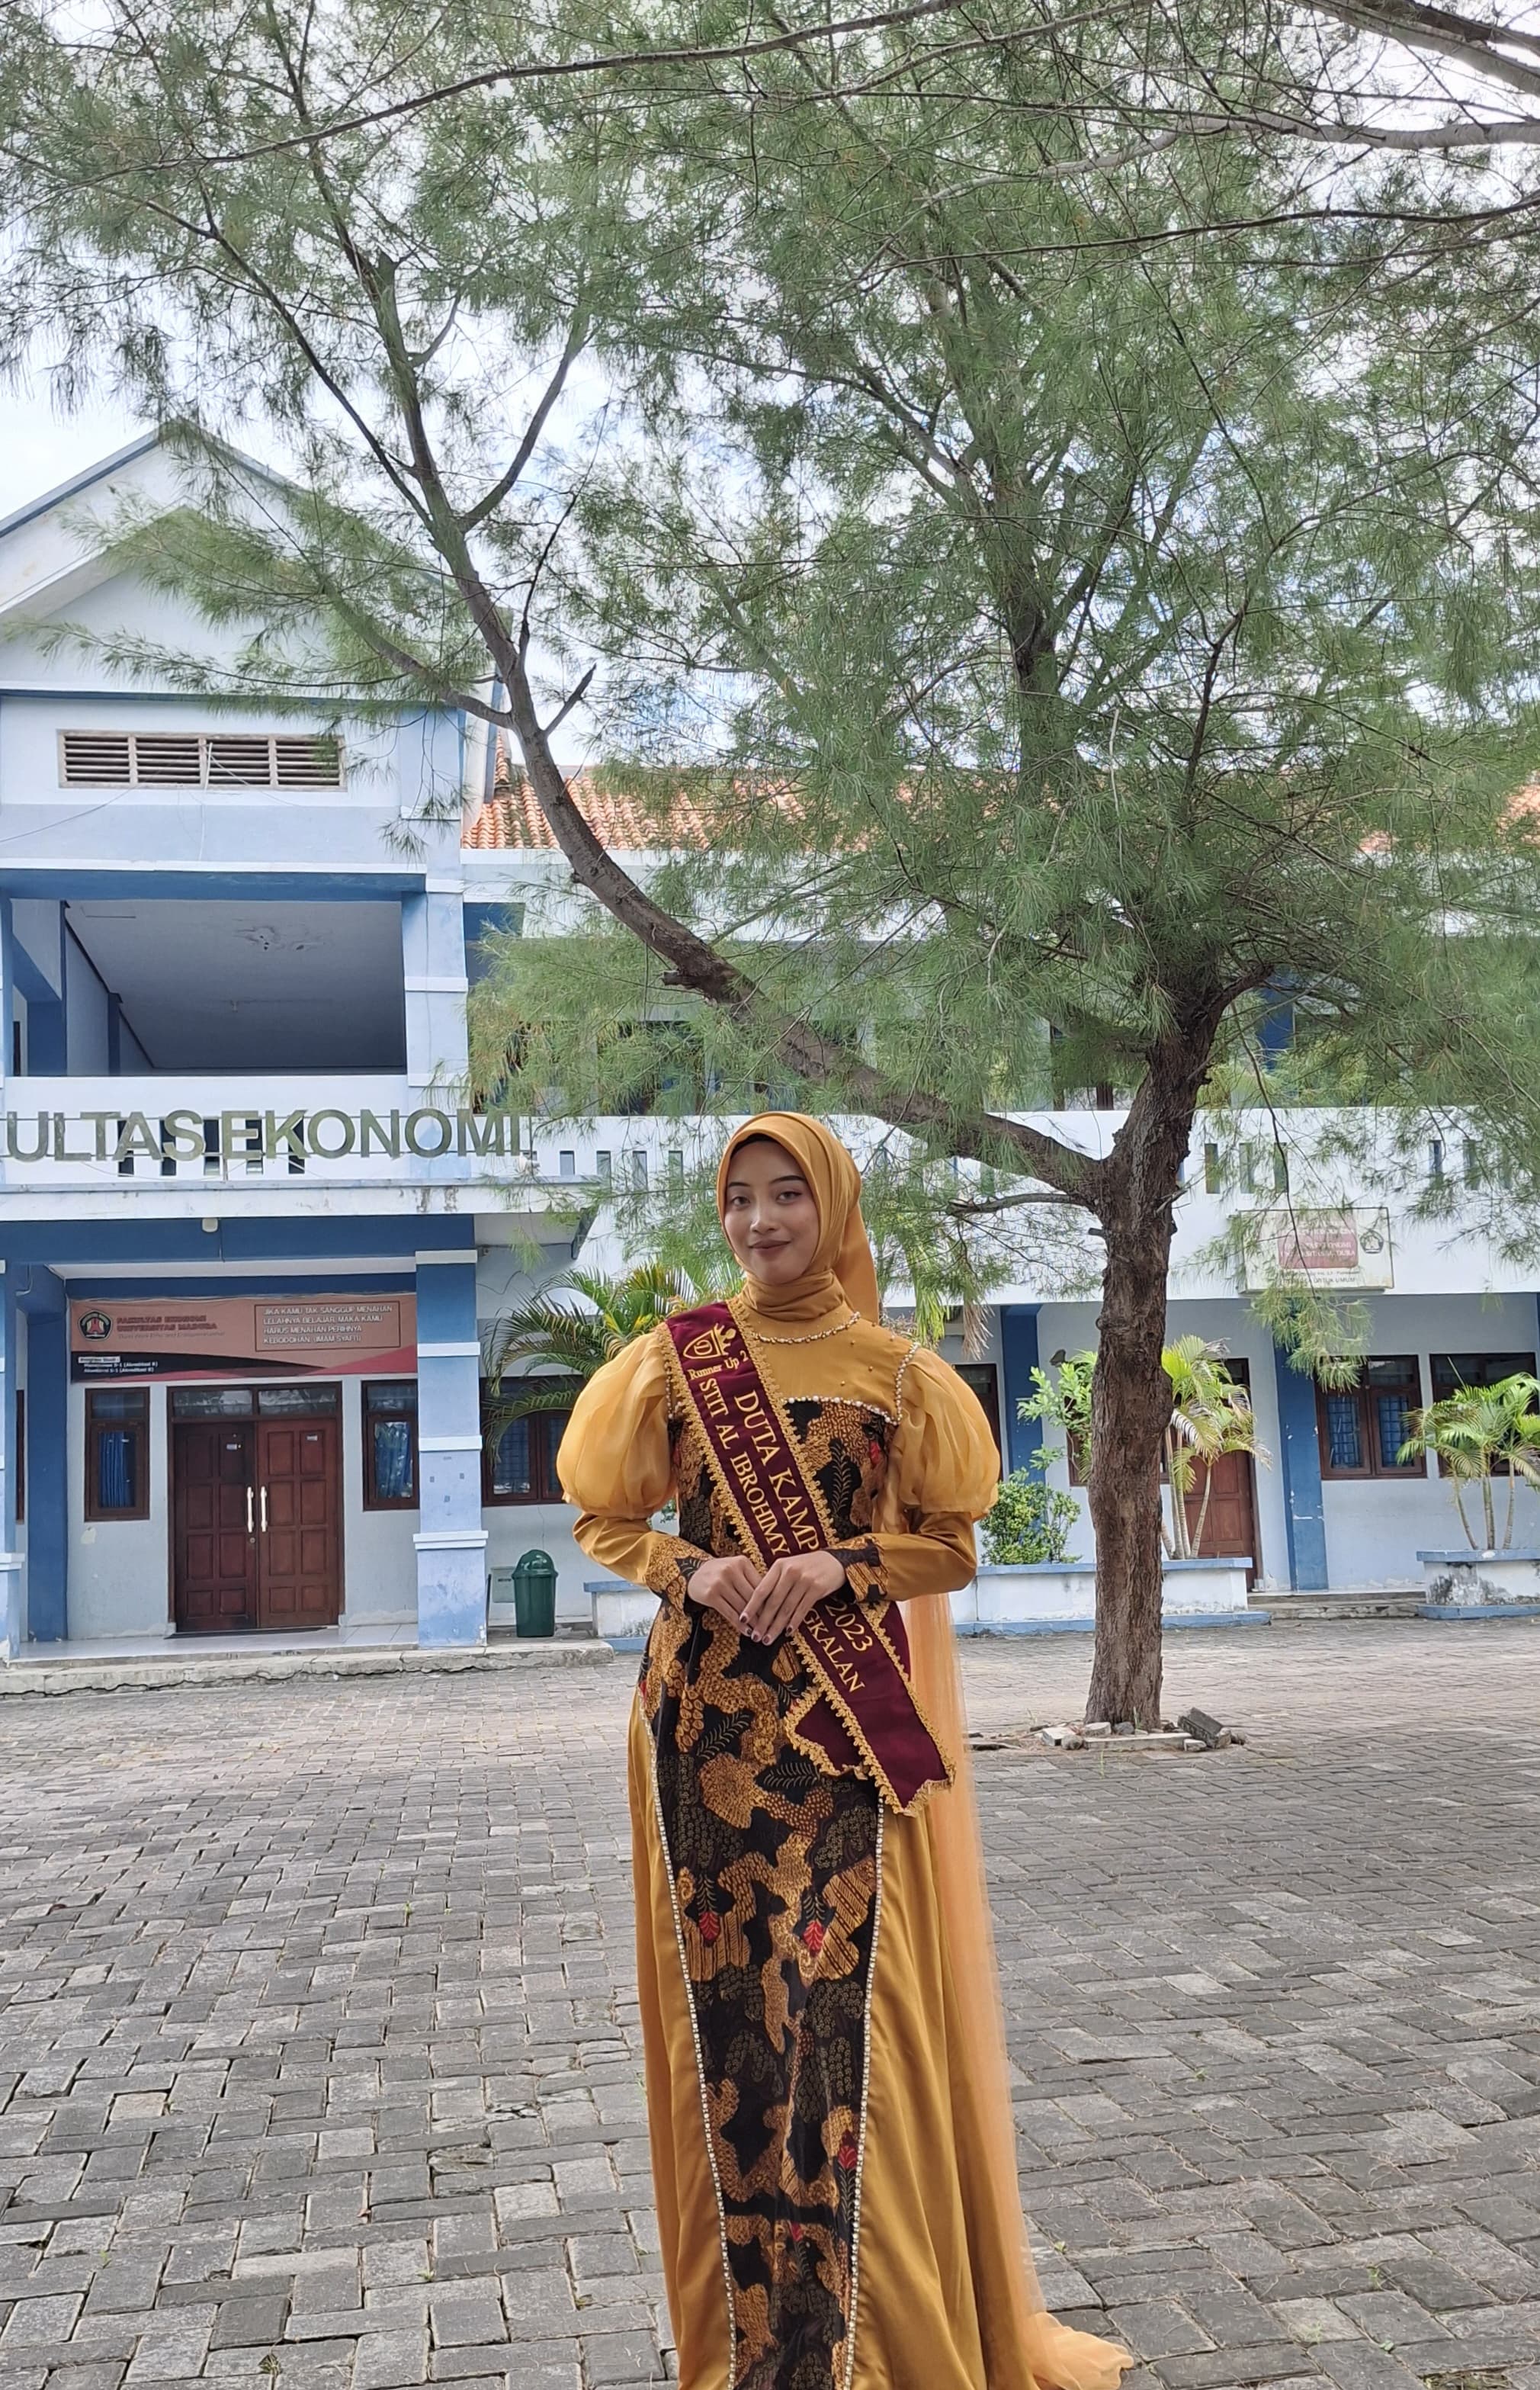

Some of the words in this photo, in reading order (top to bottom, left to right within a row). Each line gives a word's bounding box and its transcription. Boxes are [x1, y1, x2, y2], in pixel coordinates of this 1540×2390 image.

[7, 1110, 206, 1162] ULTAS
[221, 1109, 520, 1160] EKONOMI
[688, 1365, 722, 1380] Runner
[724, 1357, 740, 1370] Up
[740, 1350, 749, 1362] 2
[699, 1378, 728, 1417] STIT
[716, 1425, 740, 1450] AL
[730, 1450, 791, 1556] IBROHIMY
[734, 1389, 781, 1466] DUTA
[825, 1602, 873, 1652] 2023
